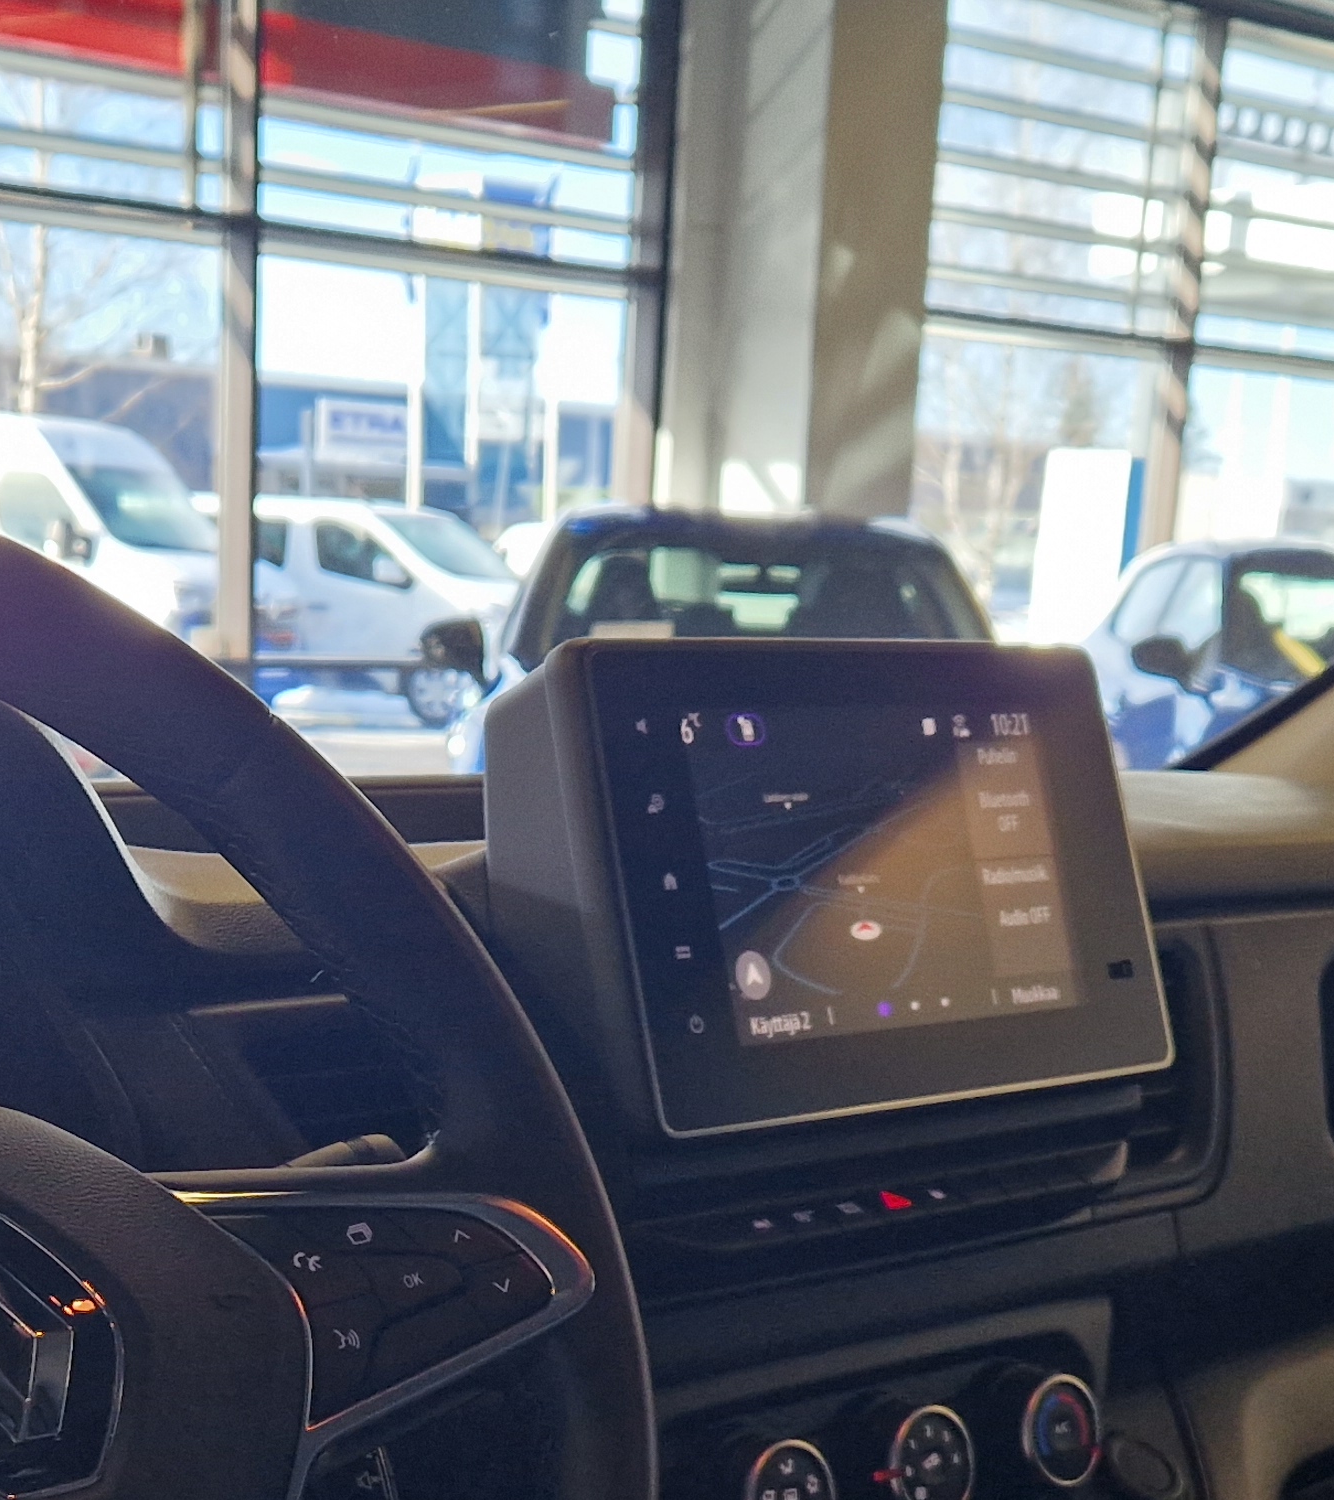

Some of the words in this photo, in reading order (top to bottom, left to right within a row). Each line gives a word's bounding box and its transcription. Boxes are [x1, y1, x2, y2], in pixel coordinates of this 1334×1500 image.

[990, 712, 1029, 736] 10:21
[749, 1013, 801, 1039] Käyttäjä
[800, 1010, 813, 1031] 2
[402, 1271, 425, 1289] OK
